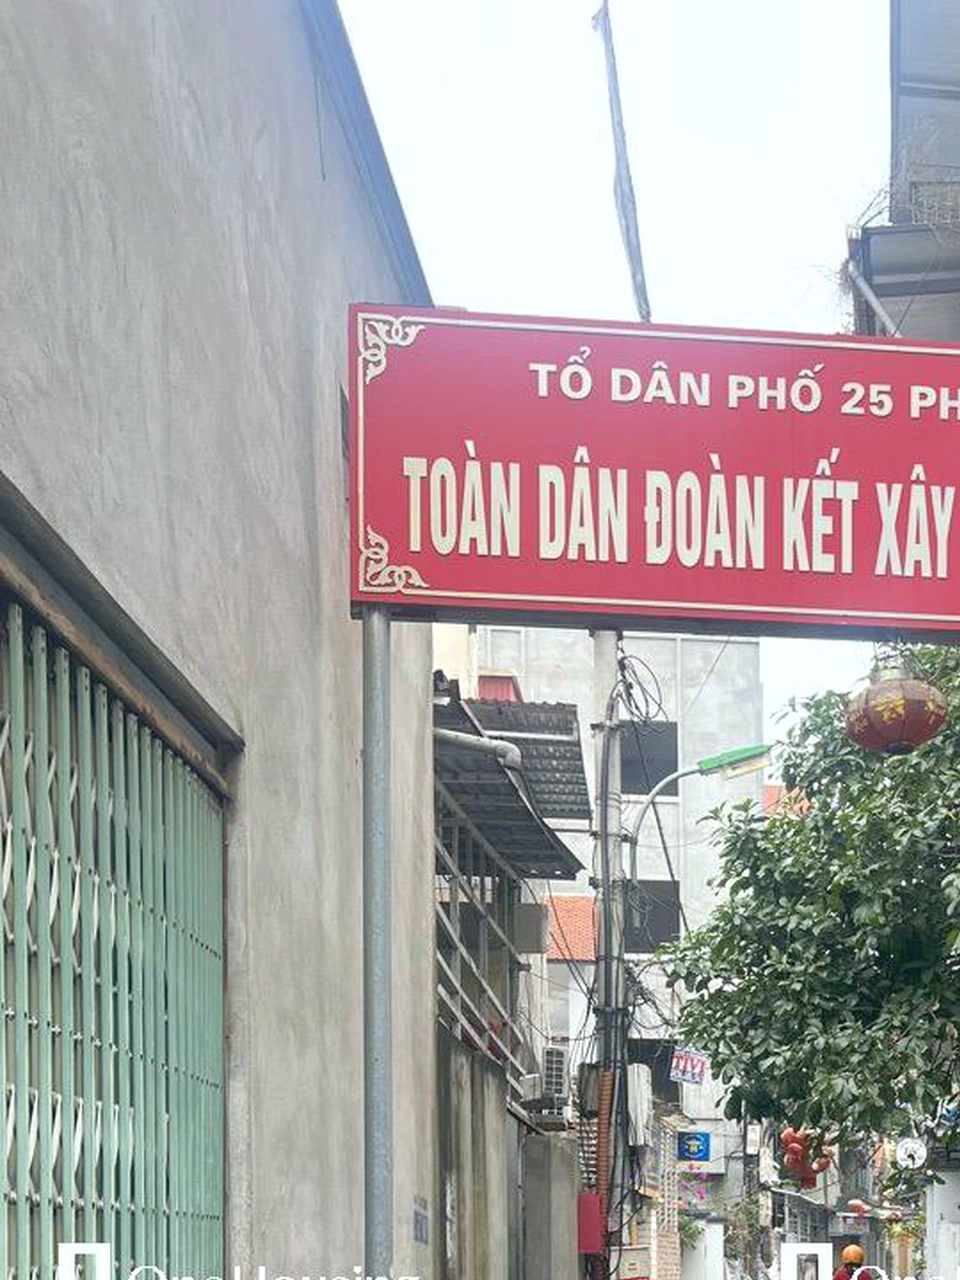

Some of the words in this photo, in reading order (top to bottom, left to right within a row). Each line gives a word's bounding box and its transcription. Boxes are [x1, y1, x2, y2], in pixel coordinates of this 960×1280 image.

[529, 345, 593, 400] TỔ
[611, 361, 711, 407] DÂN
[728, 363, 824, 413] PHỐ
[841, 382, 894, 417] 25
[403, 439, 520, 558] TOÀN
[538, 445, 628, 563] DÂN
[644, 453, 765, 570] ĐOÀN
[782, 447, 860, 575] KẾT
[874, 463, 956, 580] XÂY
